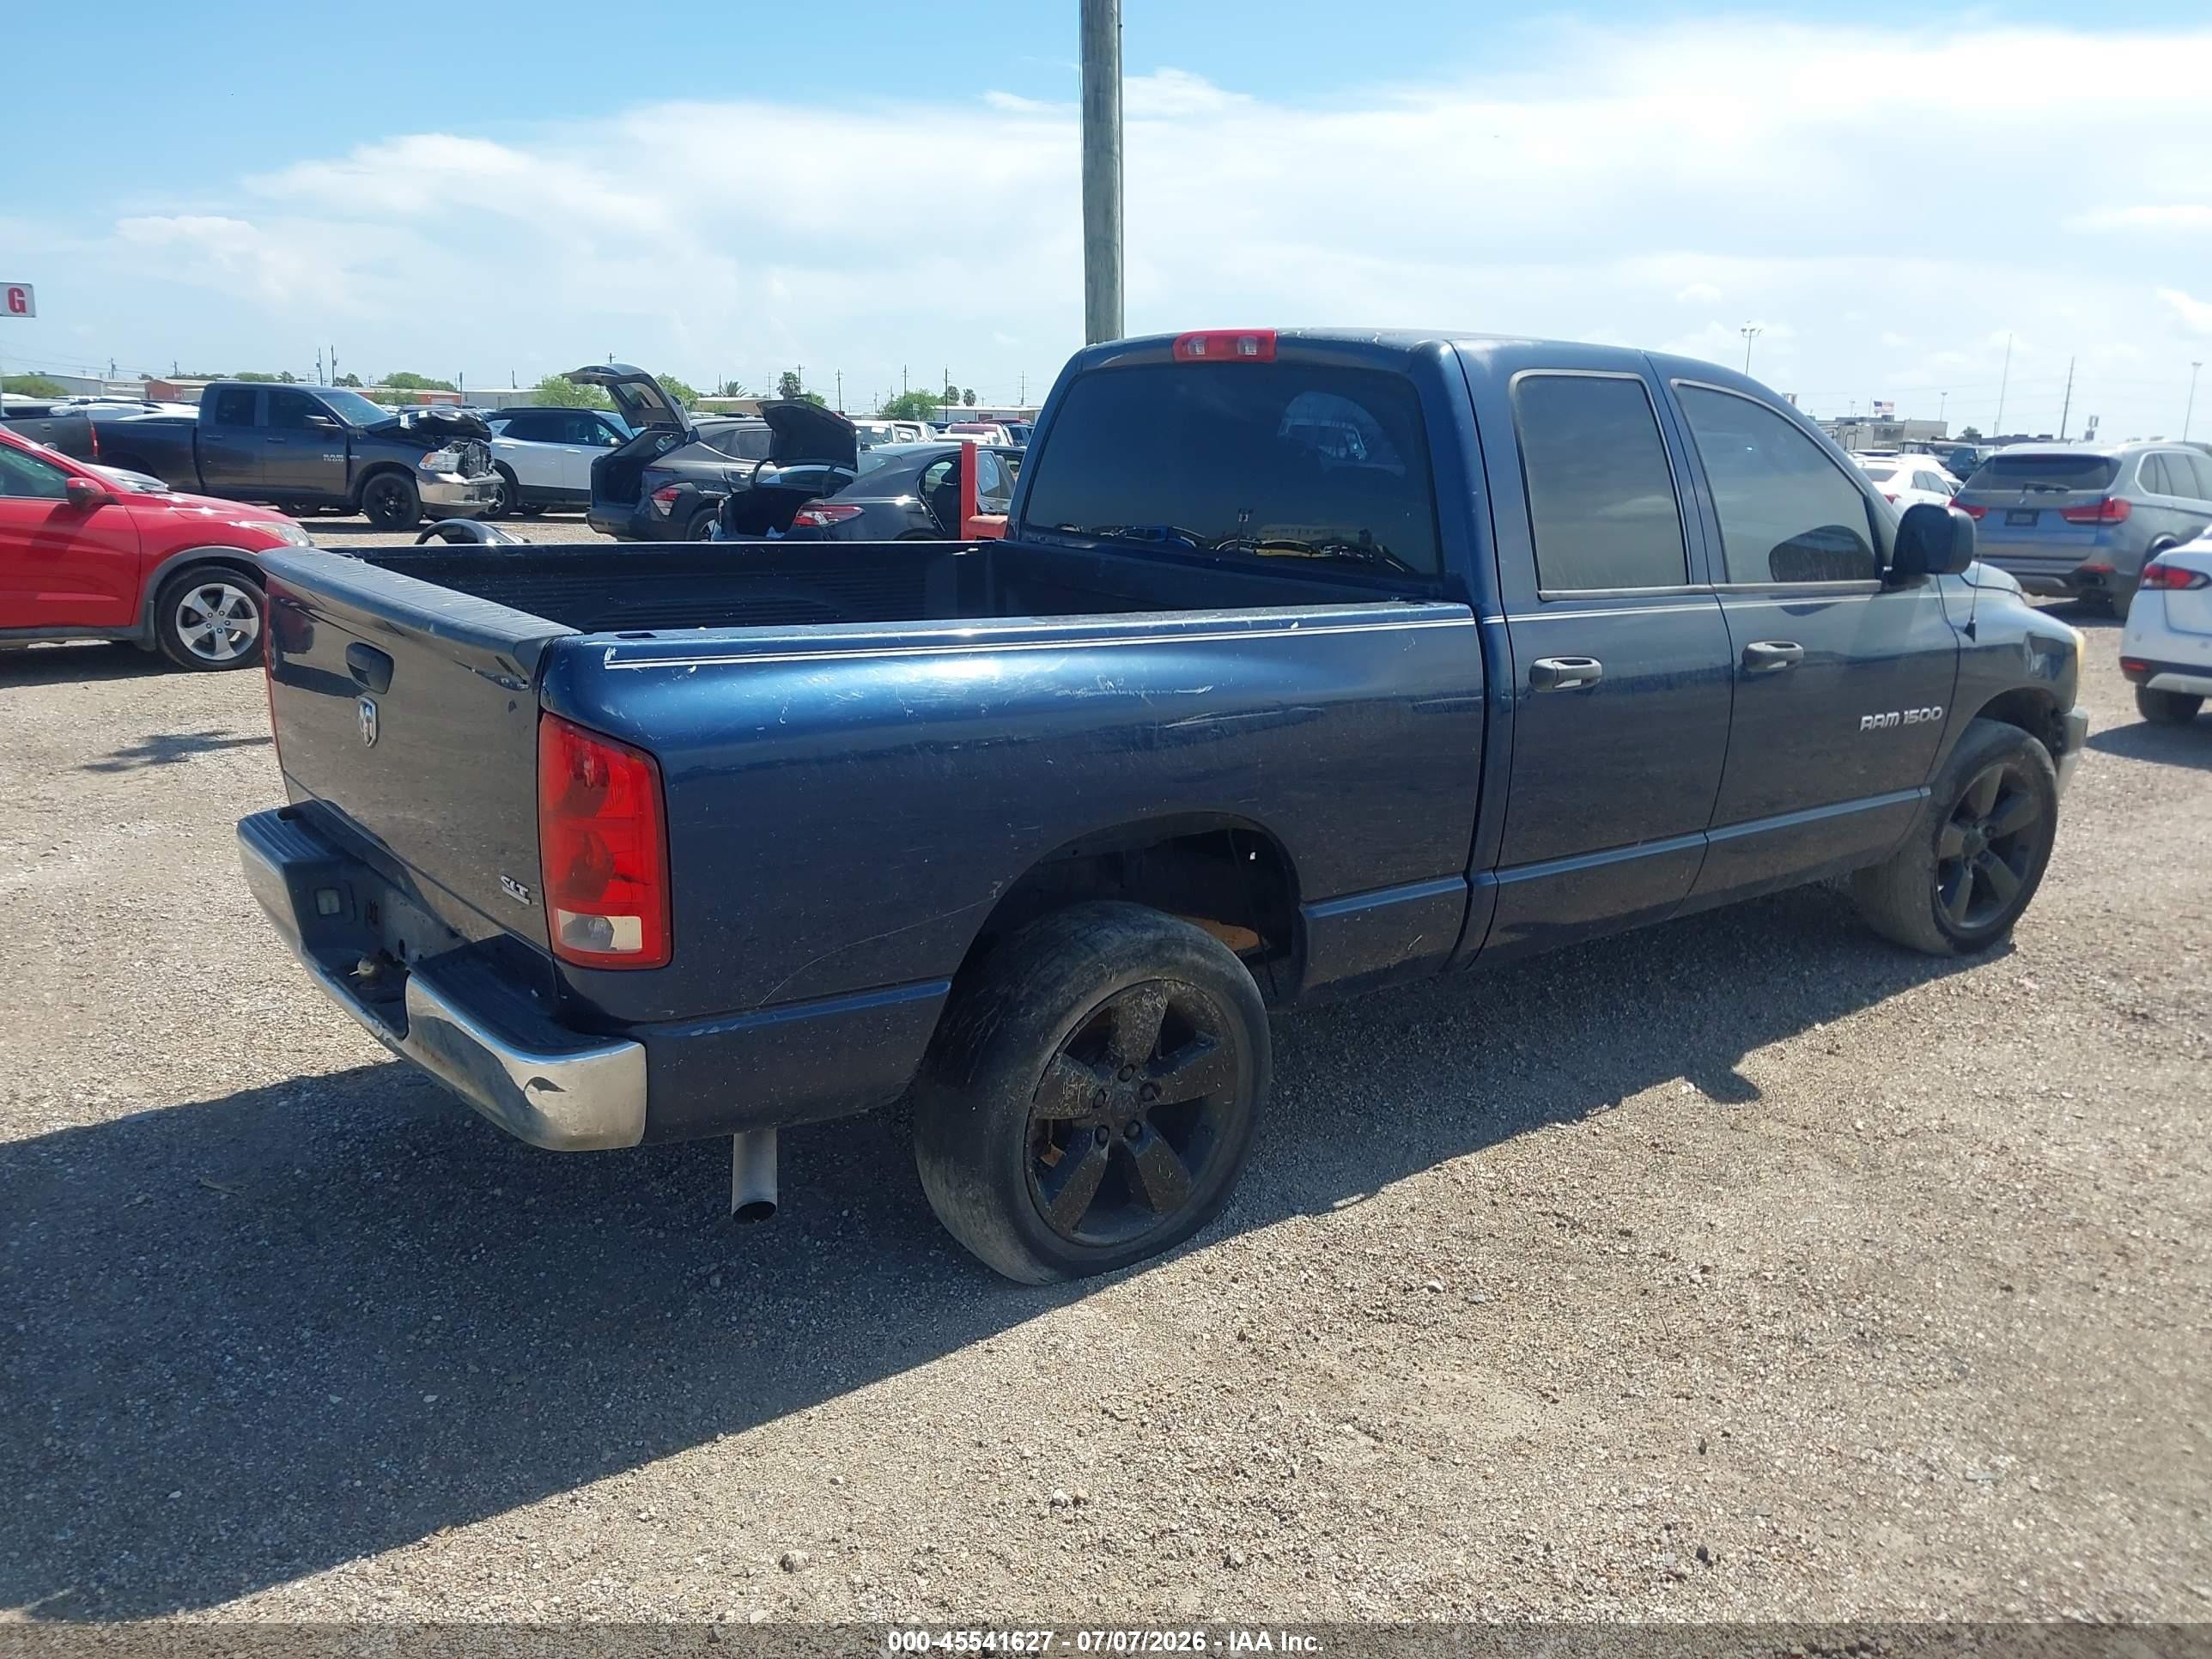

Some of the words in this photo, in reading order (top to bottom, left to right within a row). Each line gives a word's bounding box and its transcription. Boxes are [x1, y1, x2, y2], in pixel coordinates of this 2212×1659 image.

[8, 287, 27, 313] G
[1860, 712, 1899, 731] RAM
[1903, 706, 1942, 724] 1500
